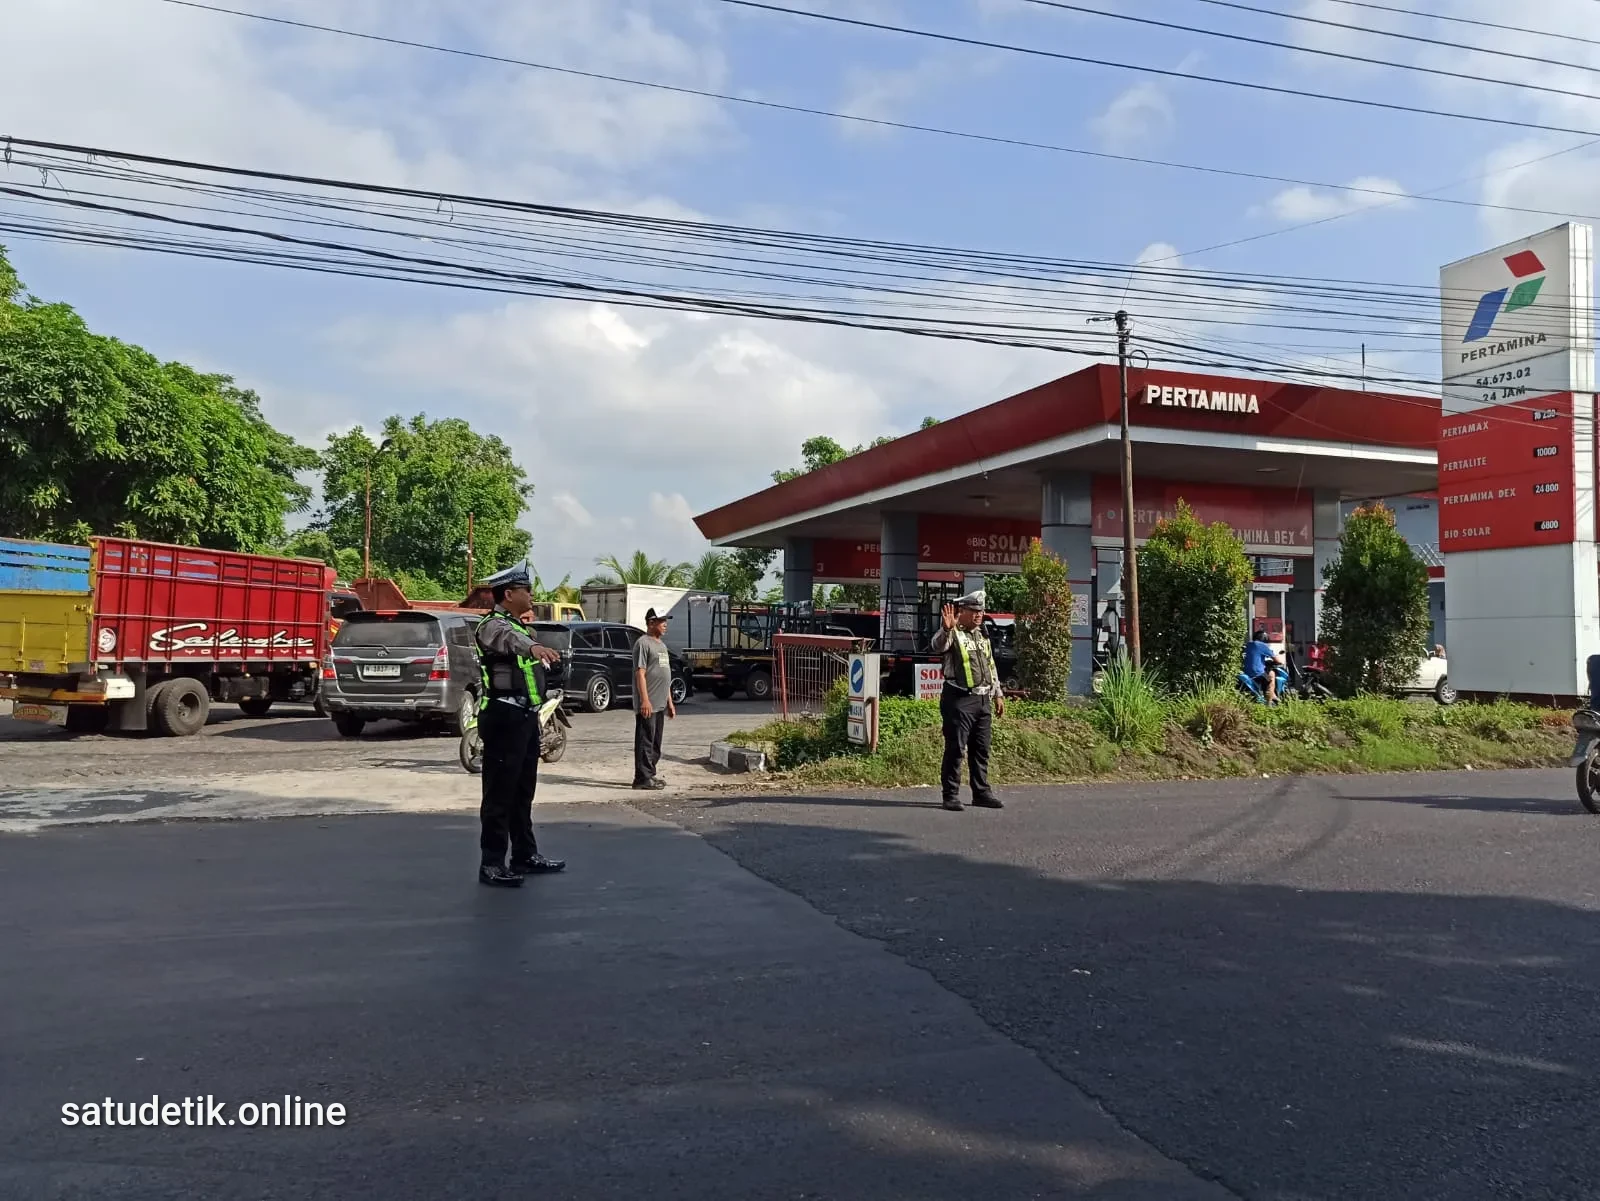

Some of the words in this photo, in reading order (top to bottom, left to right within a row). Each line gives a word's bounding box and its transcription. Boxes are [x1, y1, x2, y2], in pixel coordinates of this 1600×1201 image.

[1461, 332, 1546, 363] PERTAMINA
[1476, 367, 1531, 386] 54.673.02
[1146, 384, 1260, 413] PERTAMINA
[1482, 391, 1497, 402] 24
[1502, 385, 1526, 399] JAM
[1442, 421, 1489, 438] PERTAMAX
[1443, 456, 1487, 472] PERTALITE
[1537, 446, 1557, 457] 10000
[1443, 490, 1494, 505] PERTAMINA
[1498, 488, 1516, 499] DEX
[1274, 530, 1295, 545] DEX
[1444, 529, 1459, 539] BIO
[1462, 526, 1491, 537] SOLAR
[1541, 520, 1559, 530] 6800
[922, 544, 931, 557] 2
[816, 562, 824, 572] 3
